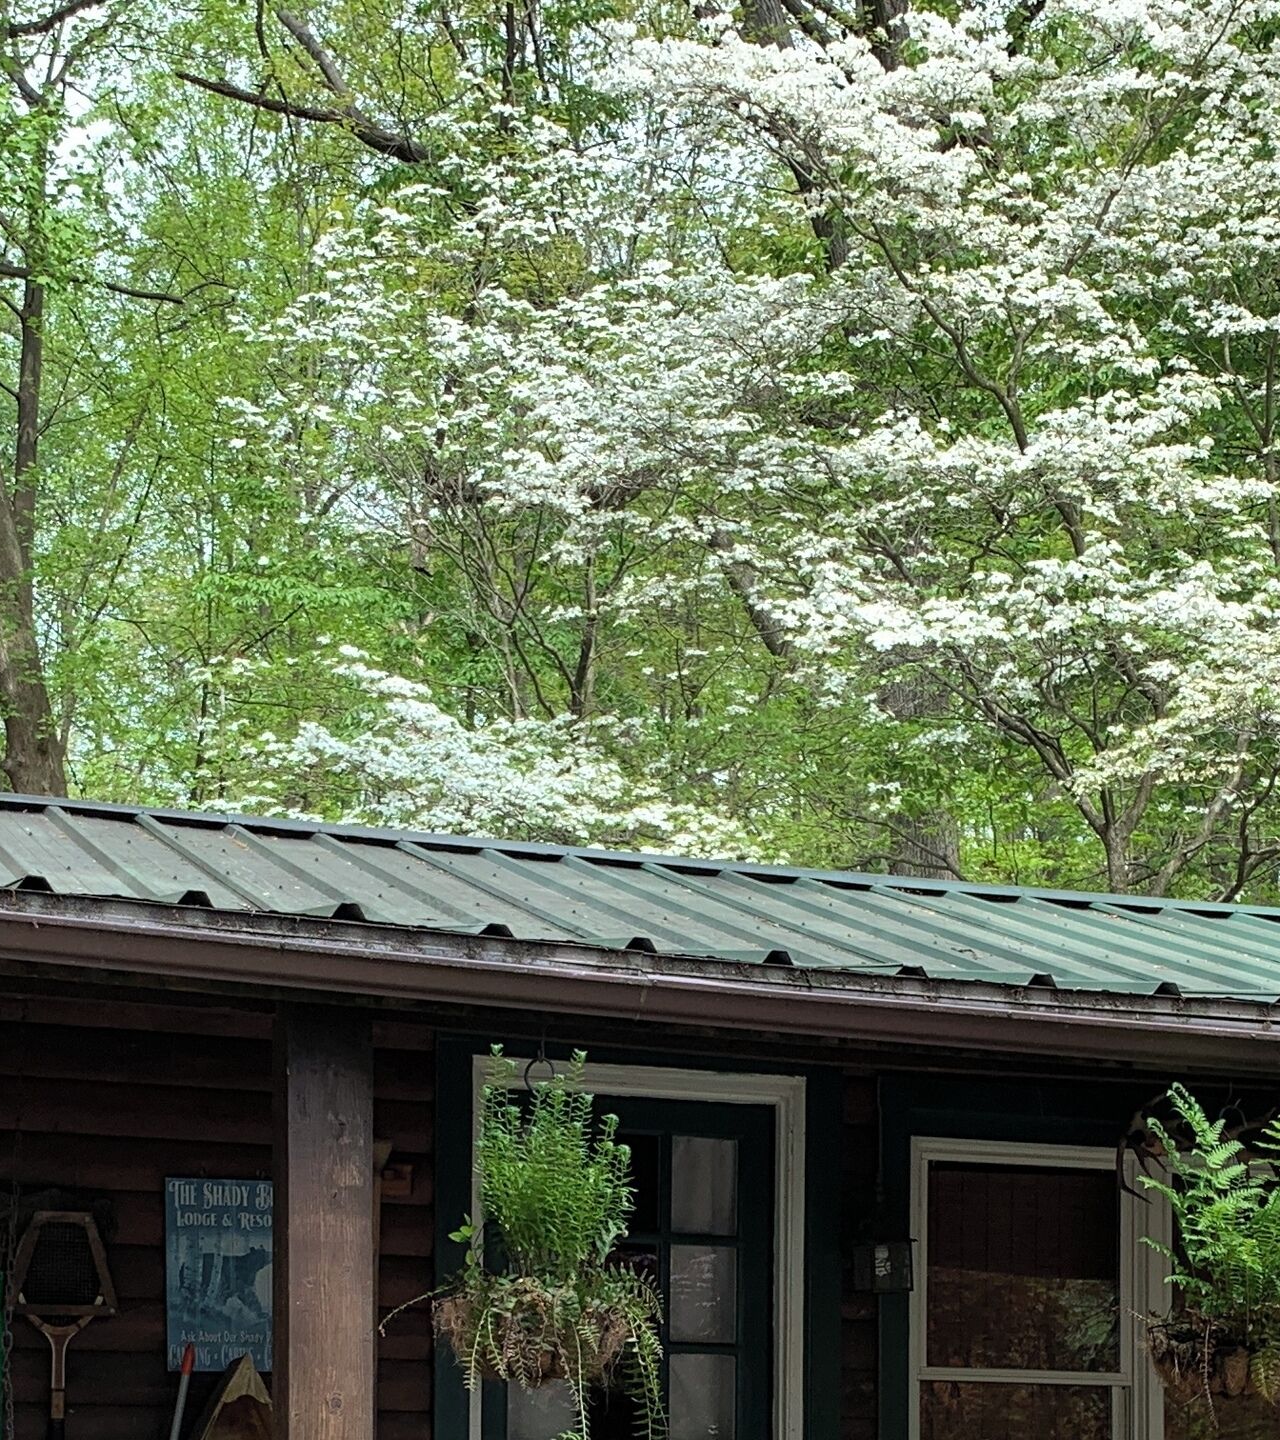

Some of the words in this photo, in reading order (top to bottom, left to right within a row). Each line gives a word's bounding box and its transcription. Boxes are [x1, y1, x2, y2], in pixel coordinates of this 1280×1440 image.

[168, 1181, 197, 1208] THE
[202, 1182, 250, 1210] SHADY
[176, 1210, 218, 1228] LODGE
[222, 1213, 233, 1228] &
